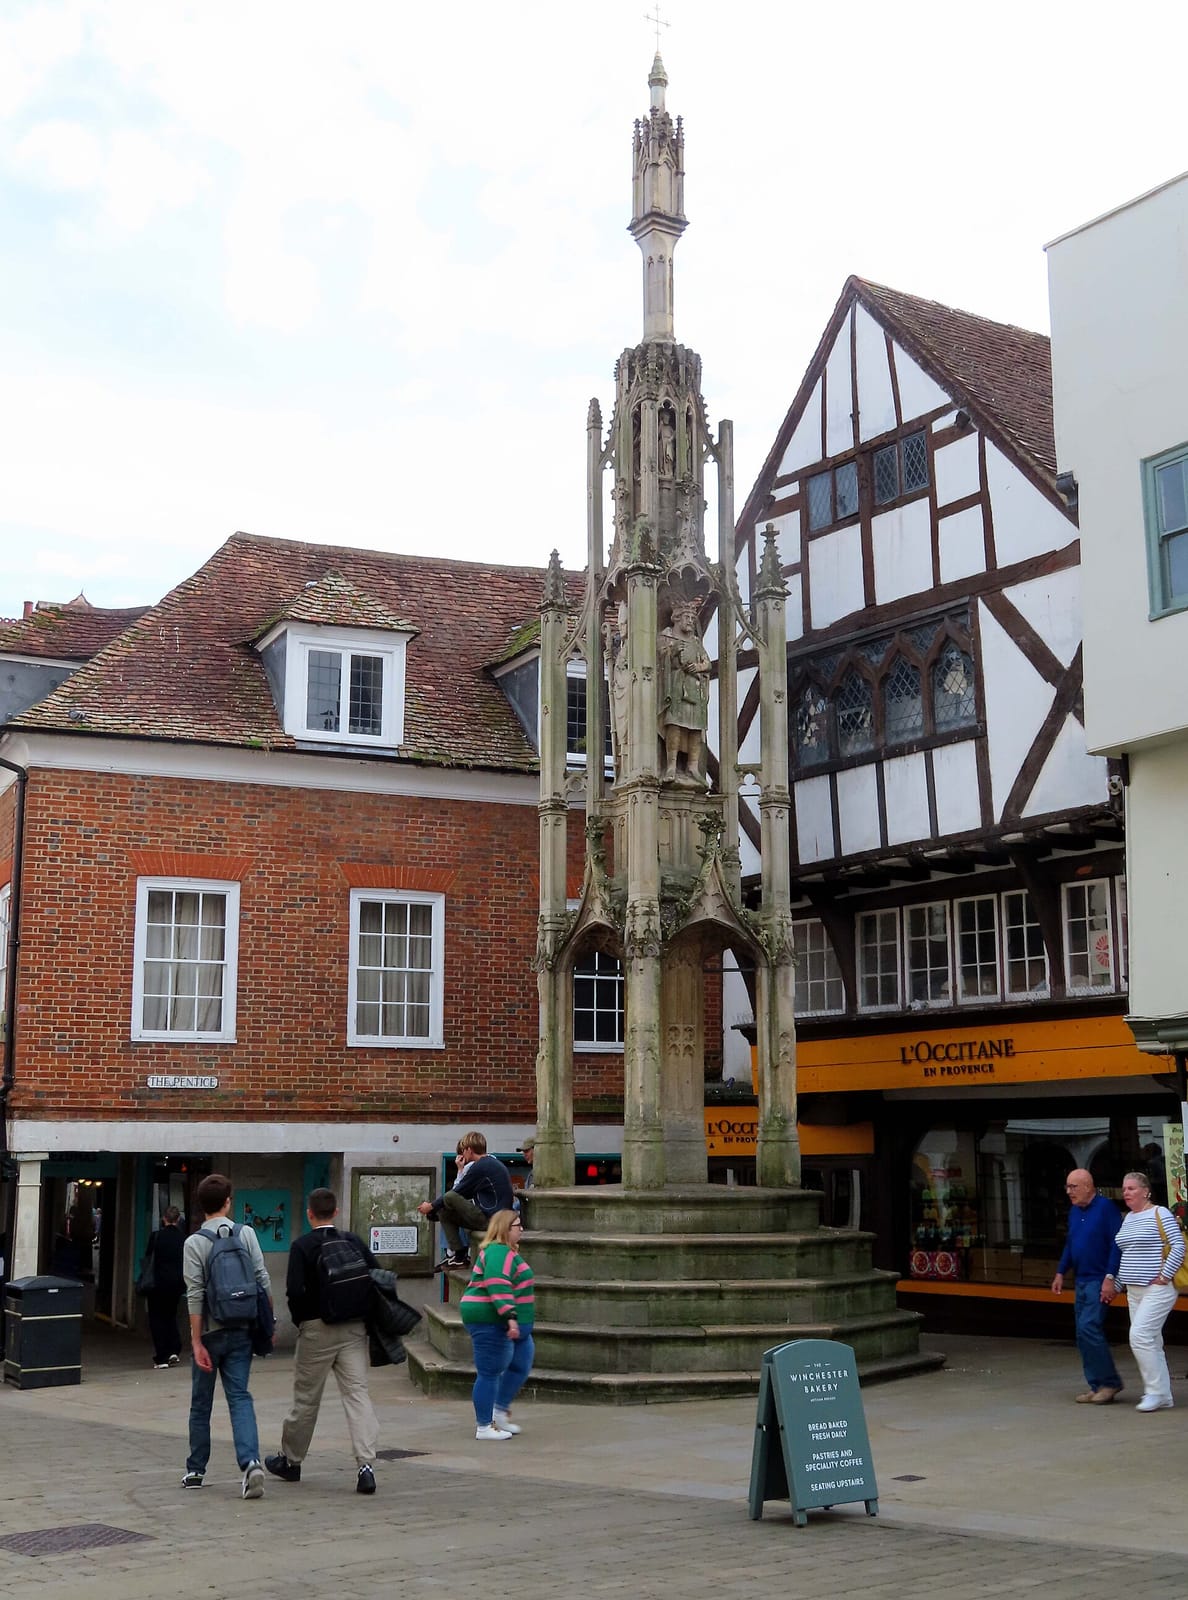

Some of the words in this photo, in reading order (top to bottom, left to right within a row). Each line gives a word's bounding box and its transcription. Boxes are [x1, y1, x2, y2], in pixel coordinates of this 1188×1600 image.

[923, 1067, 937, 1077] EN
[940, 1063, 995, 1076] PROVENCE
[150, 1076, 170, 1087] THE
[173, 1077, 216, 1088] PENTICE
[723, 1136, 734, 1144] EN
[736, 1136, 758, 1144] PROV
[790, 1369, 849, 1383] WINCHESTER
[804, 1383, 838, 1394] BAKERY
[807, 1422, 828, 1431] BREAD
[828, 1420, 848, 1429] BAKED
[811, 1432, 831, 1441] FRESH
[831, 1430, 847, 1439] DAILY
[812, 1450, 839, 1461] PASTRIES
[840, 1449, 853, 1458] AND
[805, 1461, 839, 1472] SPECIALITY
[839, 1457, 864, 1468] COFFEE
[810, 1481, 836, 1491] SEATING
[836, 1477, 865, 1488] UPSTAIRS
